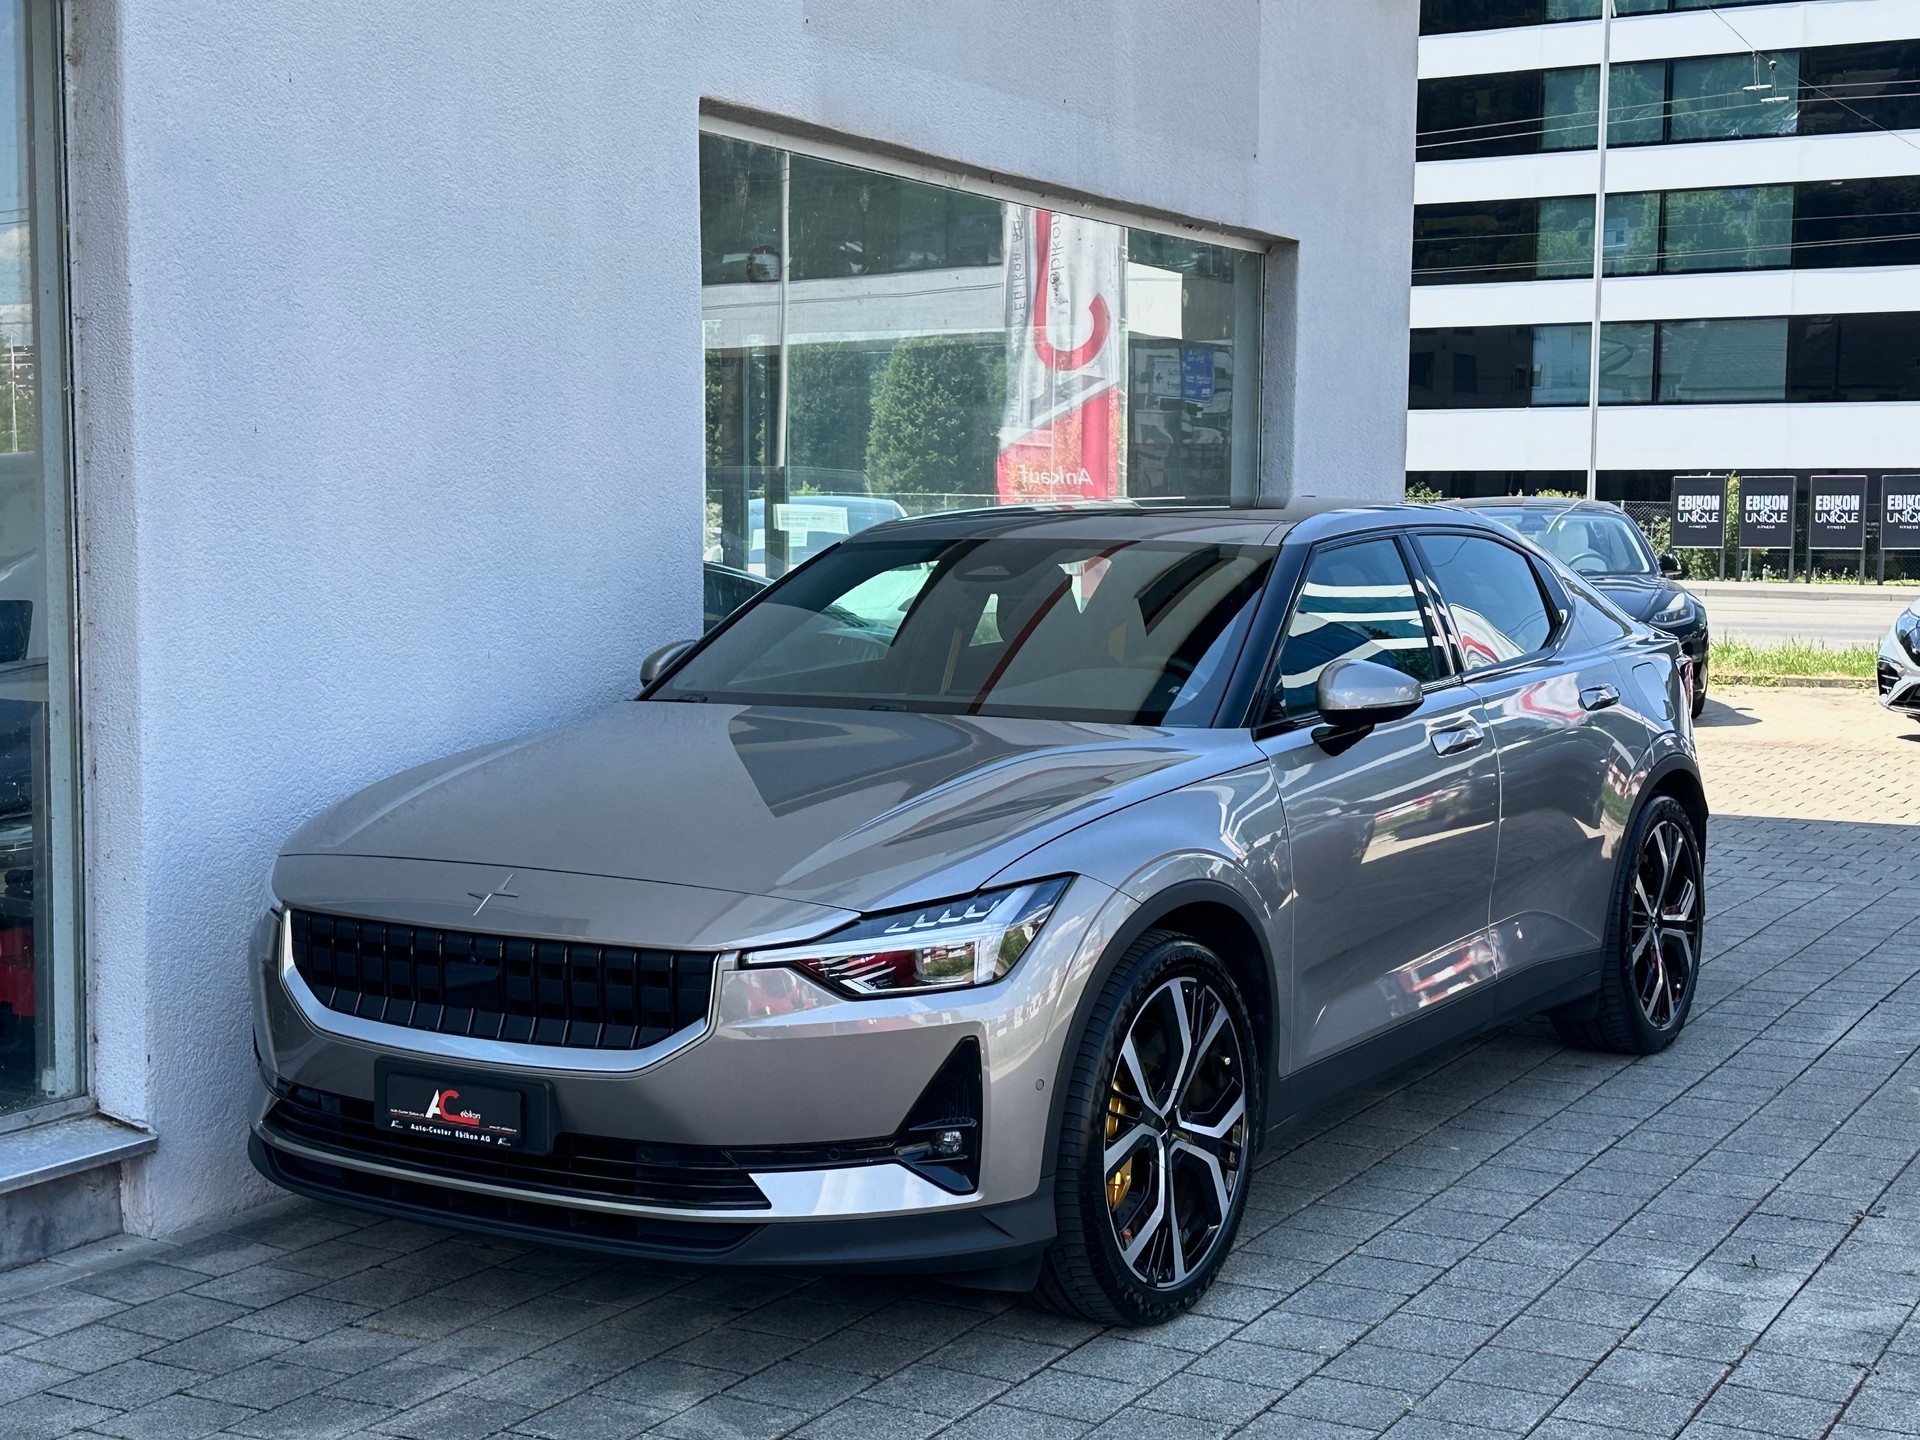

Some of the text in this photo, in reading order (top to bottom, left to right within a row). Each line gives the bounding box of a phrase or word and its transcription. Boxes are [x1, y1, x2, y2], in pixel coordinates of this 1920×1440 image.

[1677, 495, 1720, 511] EBIKON
[1745, 495, 1789, 511] EBIKON
[1815, 495, 1860, 511] EBIKON
[1677, 511, 1719, 523] UNIQUE
[1745, 511, 1788, 523] UNIQUE
[1815, 511, 1858, 524] UNIQUE
[425, 1089, 479, 1126] AC
[410, 1123, 491, 1143] Auto-Center Ebikon AG
